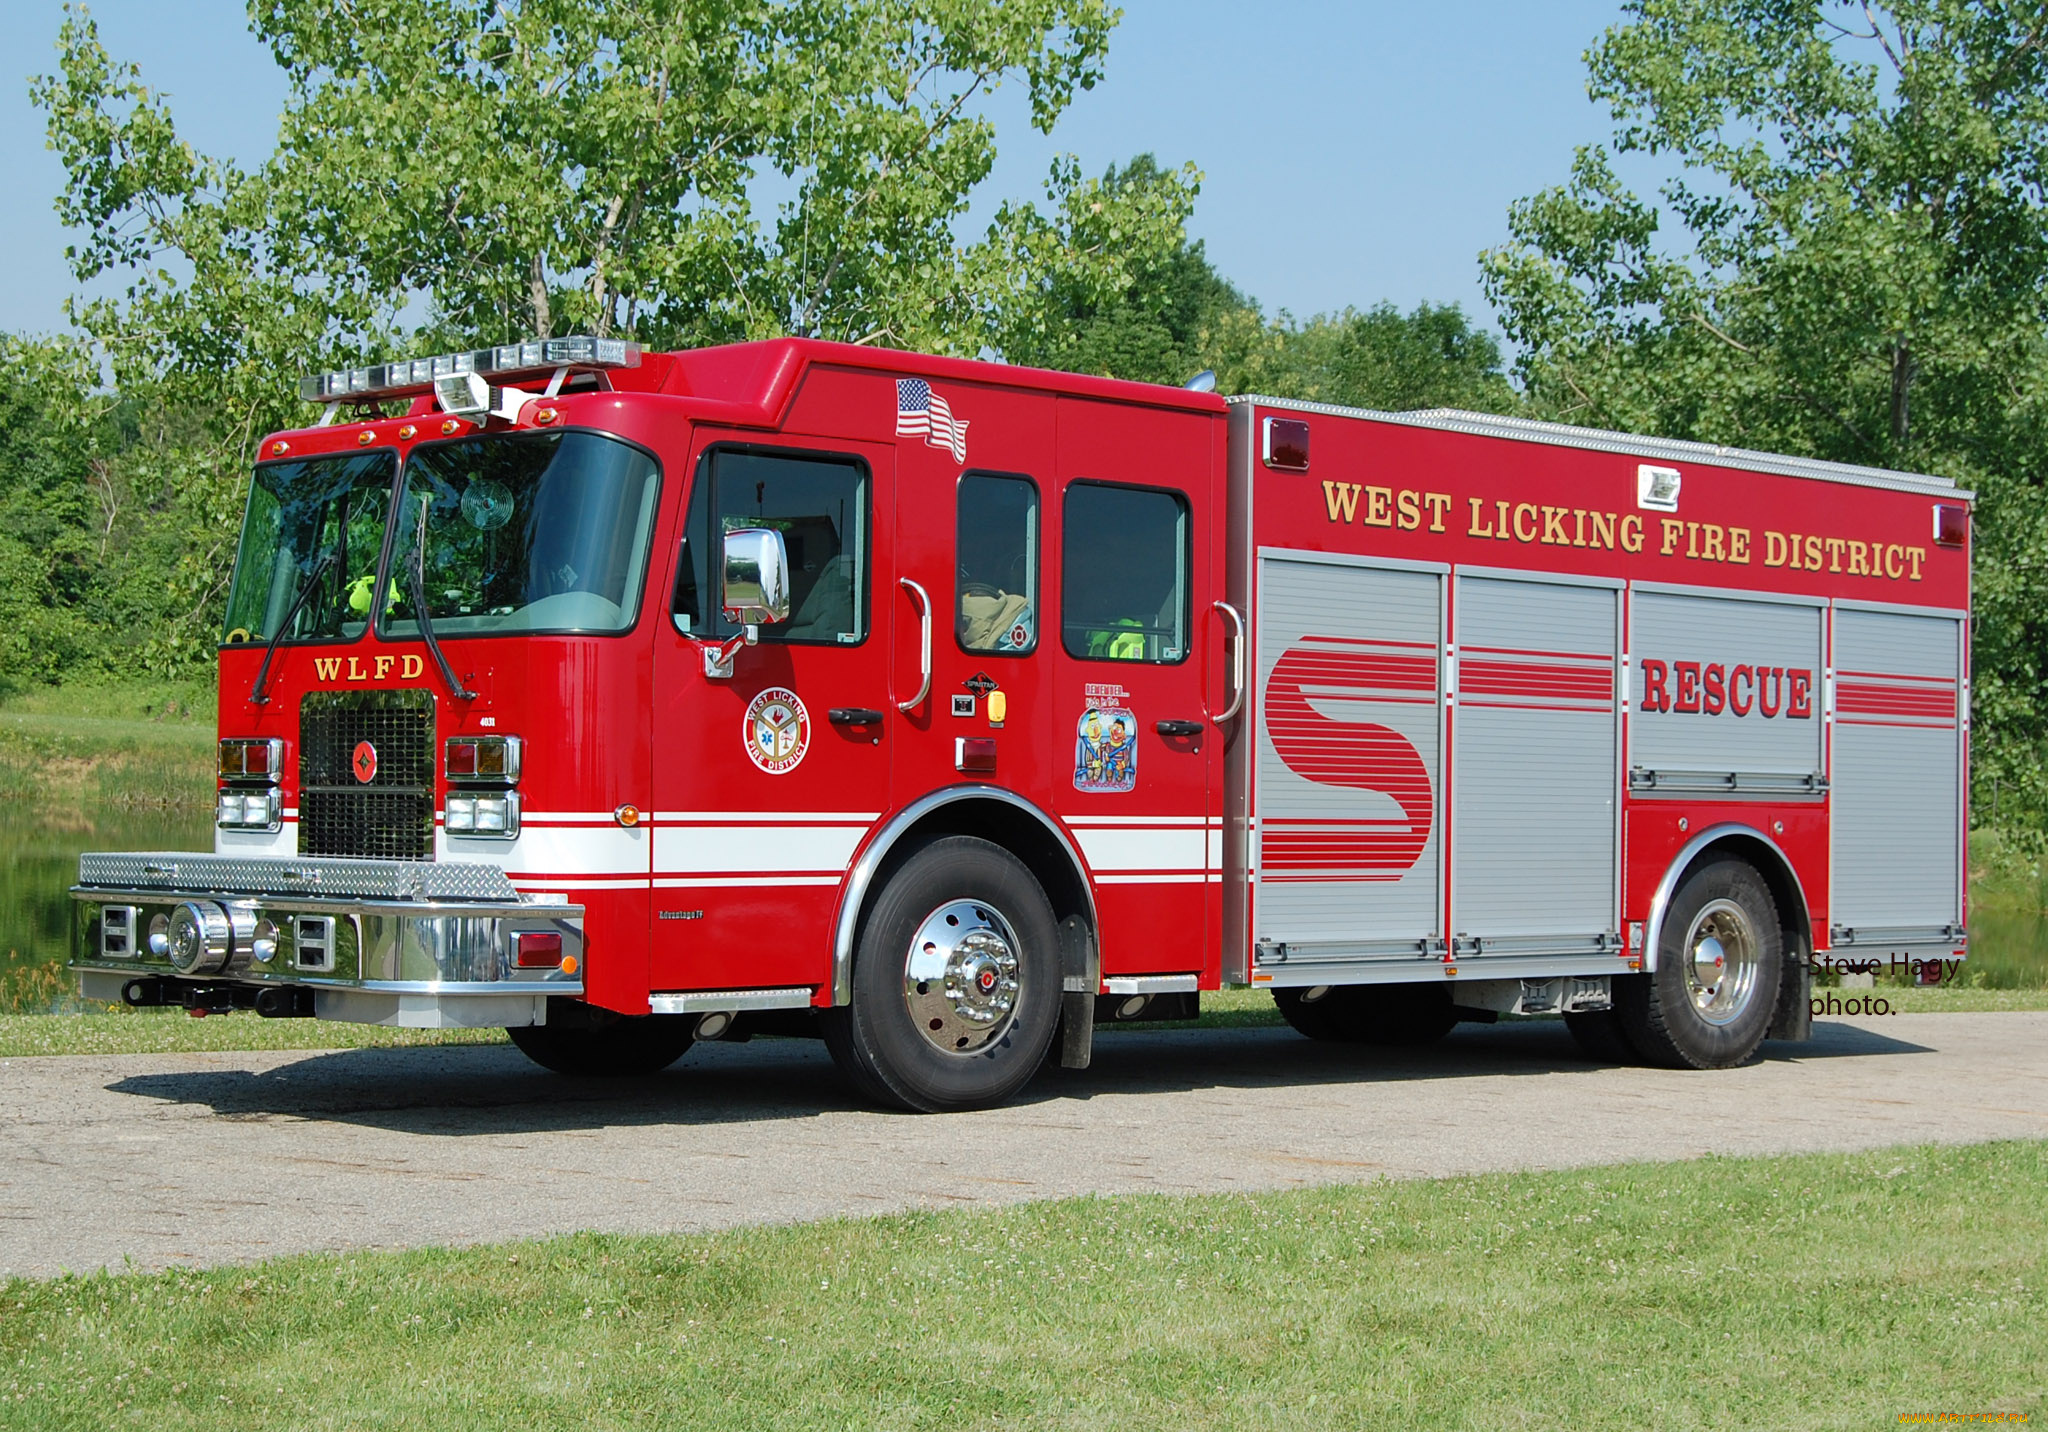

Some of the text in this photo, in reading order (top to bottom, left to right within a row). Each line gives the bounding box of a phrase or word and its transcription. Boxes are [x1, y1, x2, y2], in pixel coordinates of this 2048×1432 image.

[1322, 480, 1926, 581] WEST LICKING FIRE DISTRICT
[314, 654, 424, 682] WLFD
[966, 680, 996, 689] SPARTAN
[1641, 658, 1812, 719] RESCUE
[480, 717, 496, 727] 4031
[747, 691, 807, 723] WEST LICKING
[748, 740, 806, 771] FIRE DISTRICT
